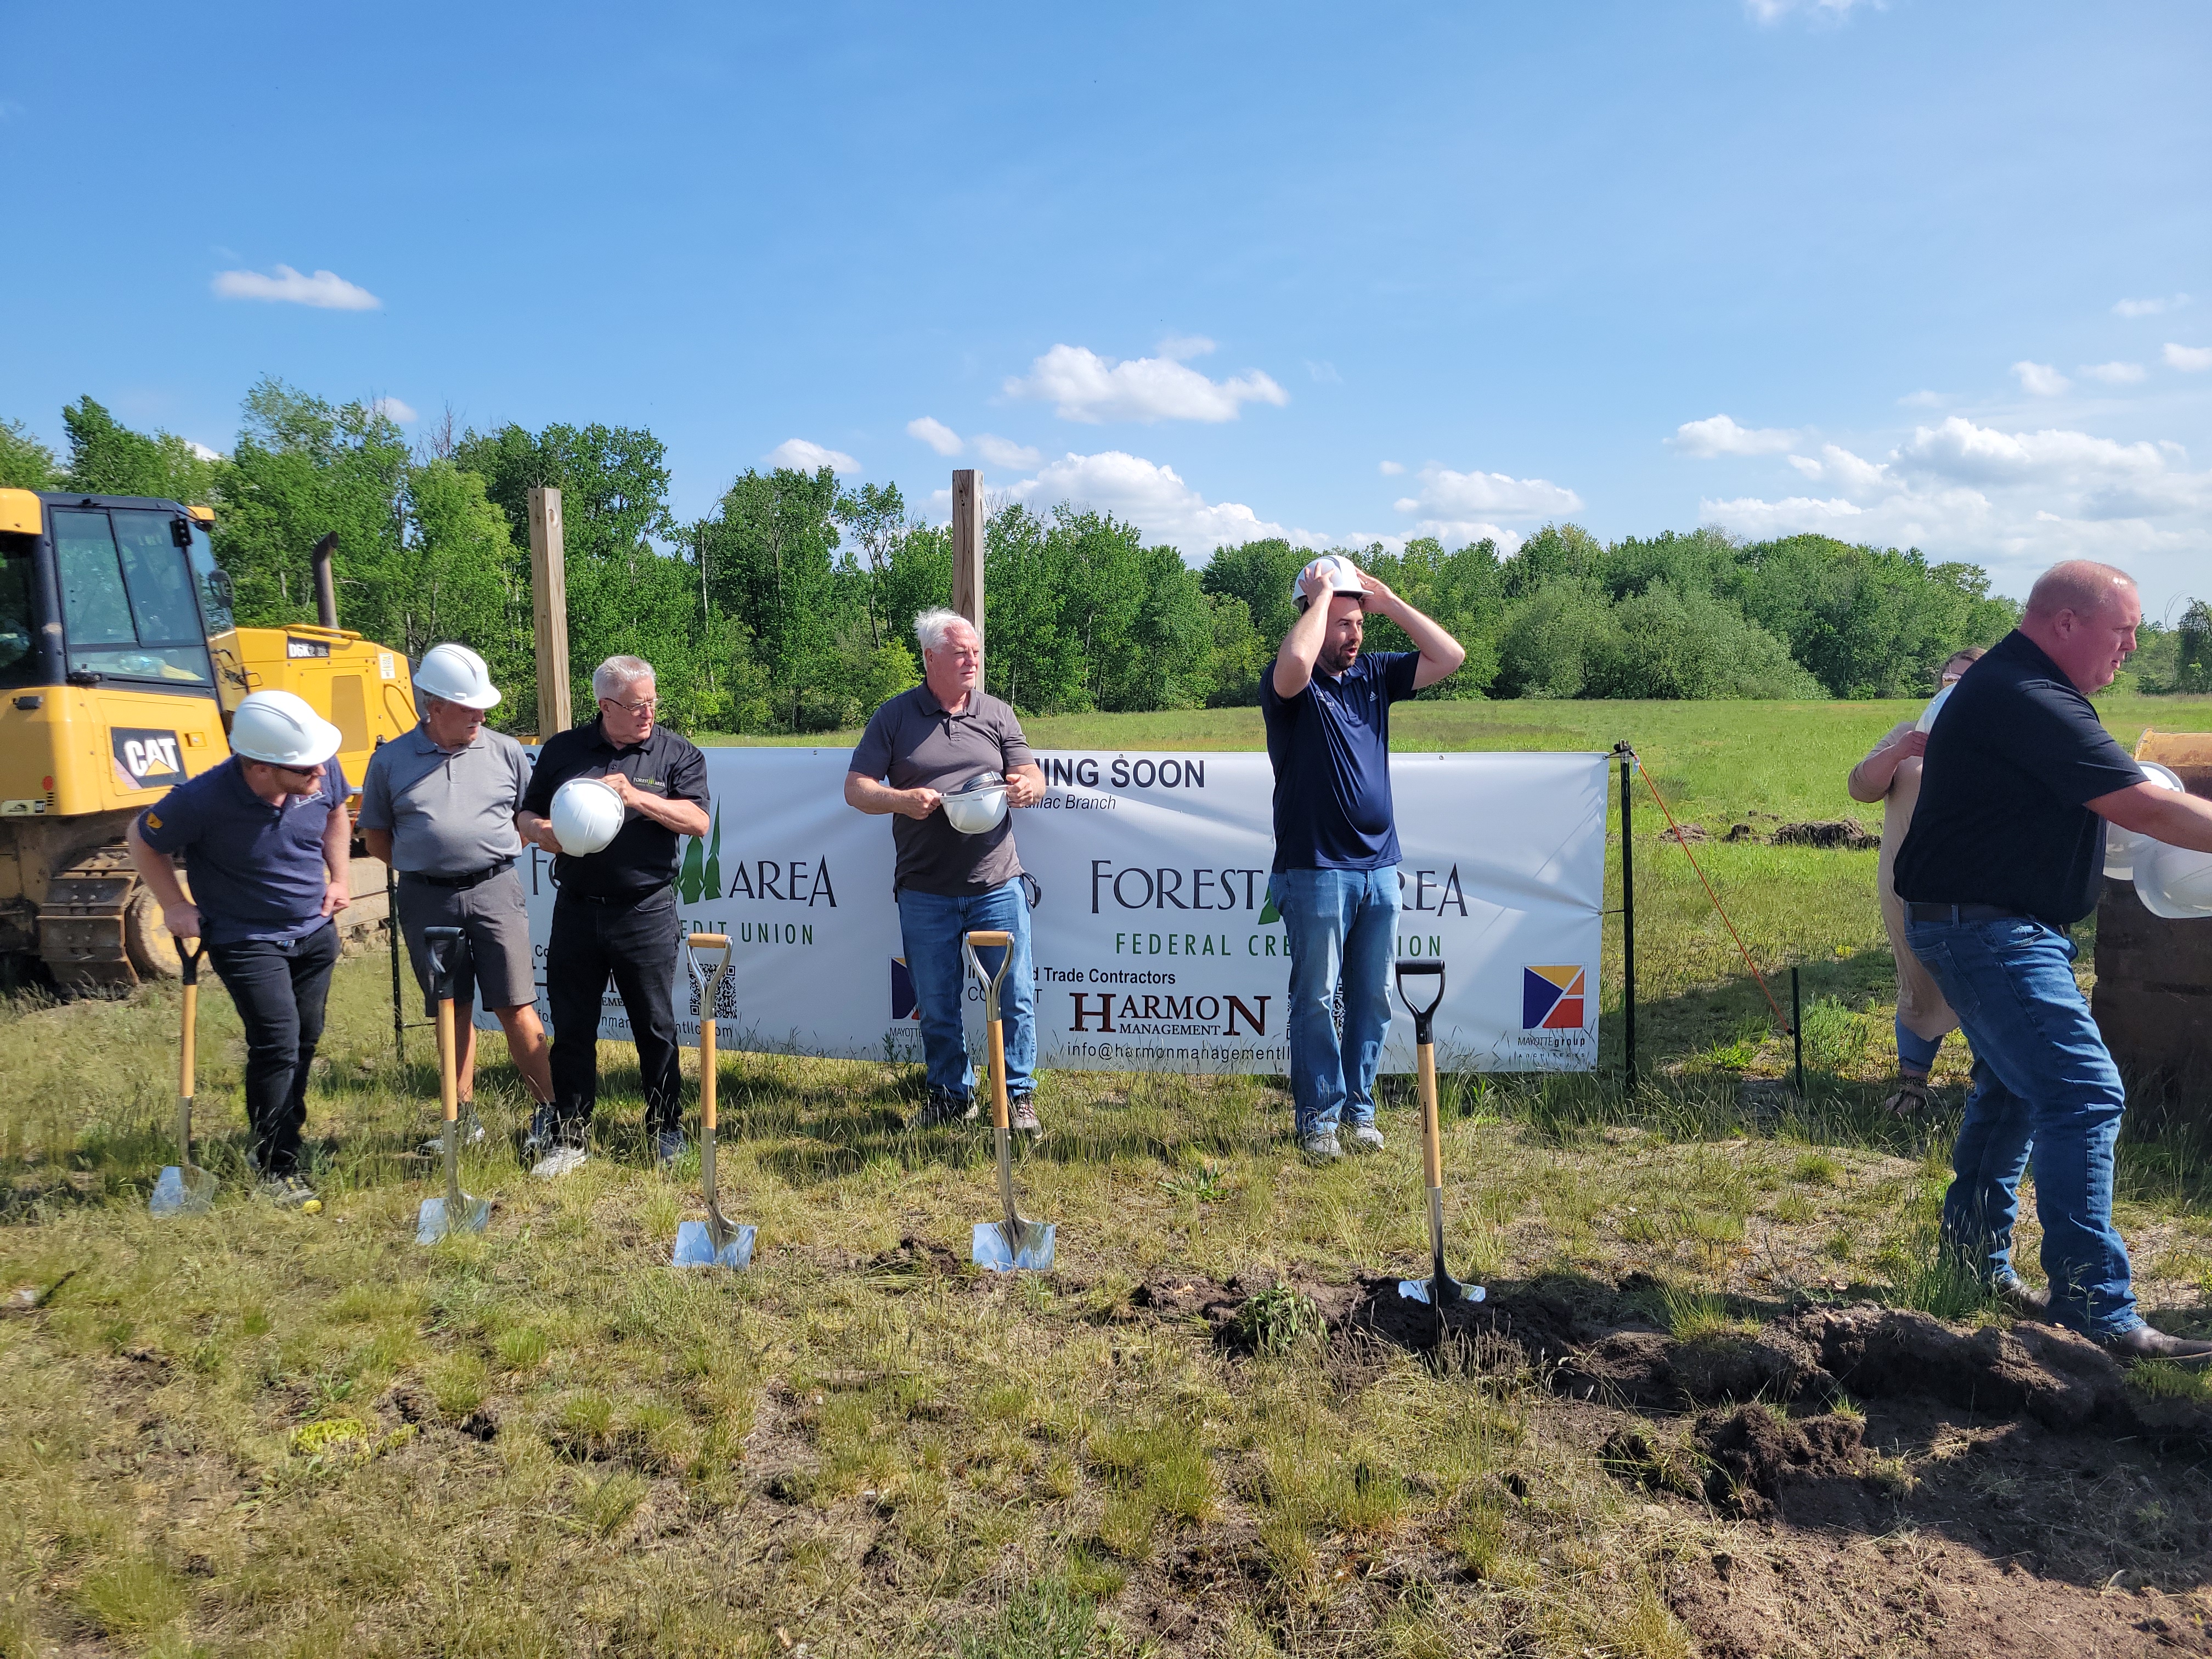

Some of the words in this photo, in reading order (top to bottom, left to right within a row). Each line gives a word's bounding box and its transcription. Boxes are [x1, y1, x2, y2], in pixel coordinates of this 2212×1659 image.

[123, 738, 180, 776] CAT
[1034, 758, 1099, 787] ING
[1110, 759, 1205, 788] SOON
[1065, 794, 1116, 810] Branch
[729, 854, 837, 907] AREA
[1091, 860, 1263, 914] FOREST
[1397, 862, 1469, 917] REA
[680, 919, 727, 939] EDIT
[741, 922, 813, 945] UNION
[1116, 933, 1232, 956] FEDERAL
[1248, 934, 1291, 956] CRE
[1397, 935, 1441, 957] ION
[1043, 967, 1084, 982] Trade
[1088, 968, 1176, 984] Contractors
[1069, 992, 1272, 1036] HARMON
[1119, 1023, 1221, 1036] MANAGEMENT
[1067, 1042, 1290, 1063] info@harmonmanagementll
